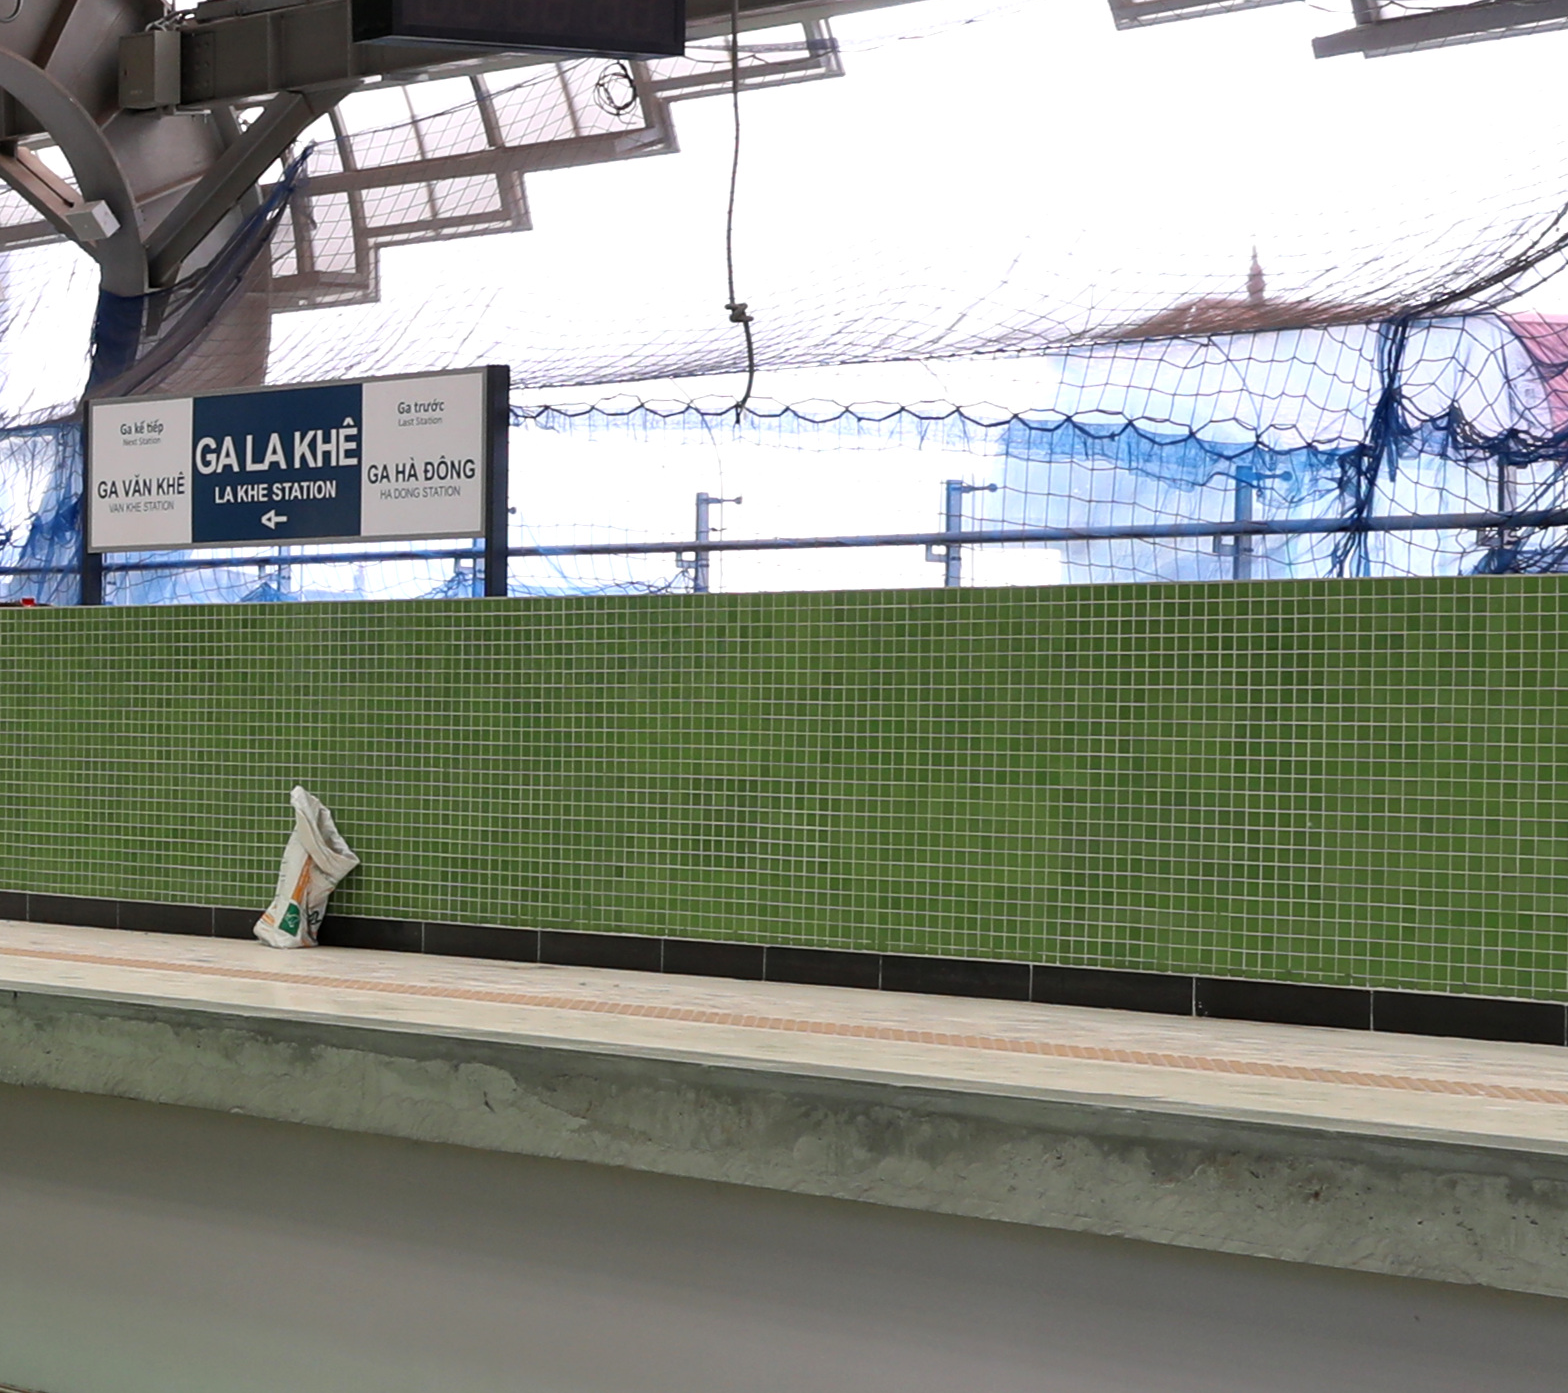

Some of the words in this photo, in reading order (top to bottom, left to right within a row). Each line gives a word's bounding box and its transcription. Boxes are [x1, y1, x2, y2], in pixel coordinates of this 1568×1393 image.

[397, 401, 412, 415] Ga
[120, 423, 132, 435] Ga
[196, 436, 241, 475] GA
[245, 432, 288, 472] LA
[294, 417, 359, 469] KHÊ
[367, 464, 391, 484] GA
[395, 456, 419, 483] HÀ
[423, 454, 476, 482] ĐÔNG
[97, 480, 119, 499] GA
[122, 474, 152, 498] VĂN
[156, 470, 185, 496] KHÊ
[215, 485, 235, 504] LA
[237, 483, 269, 503] KHE
[271, 479, 337, 501] STATION
[394, 487, 421, 500] DONG
[422, 485, 461, 498] STATION
